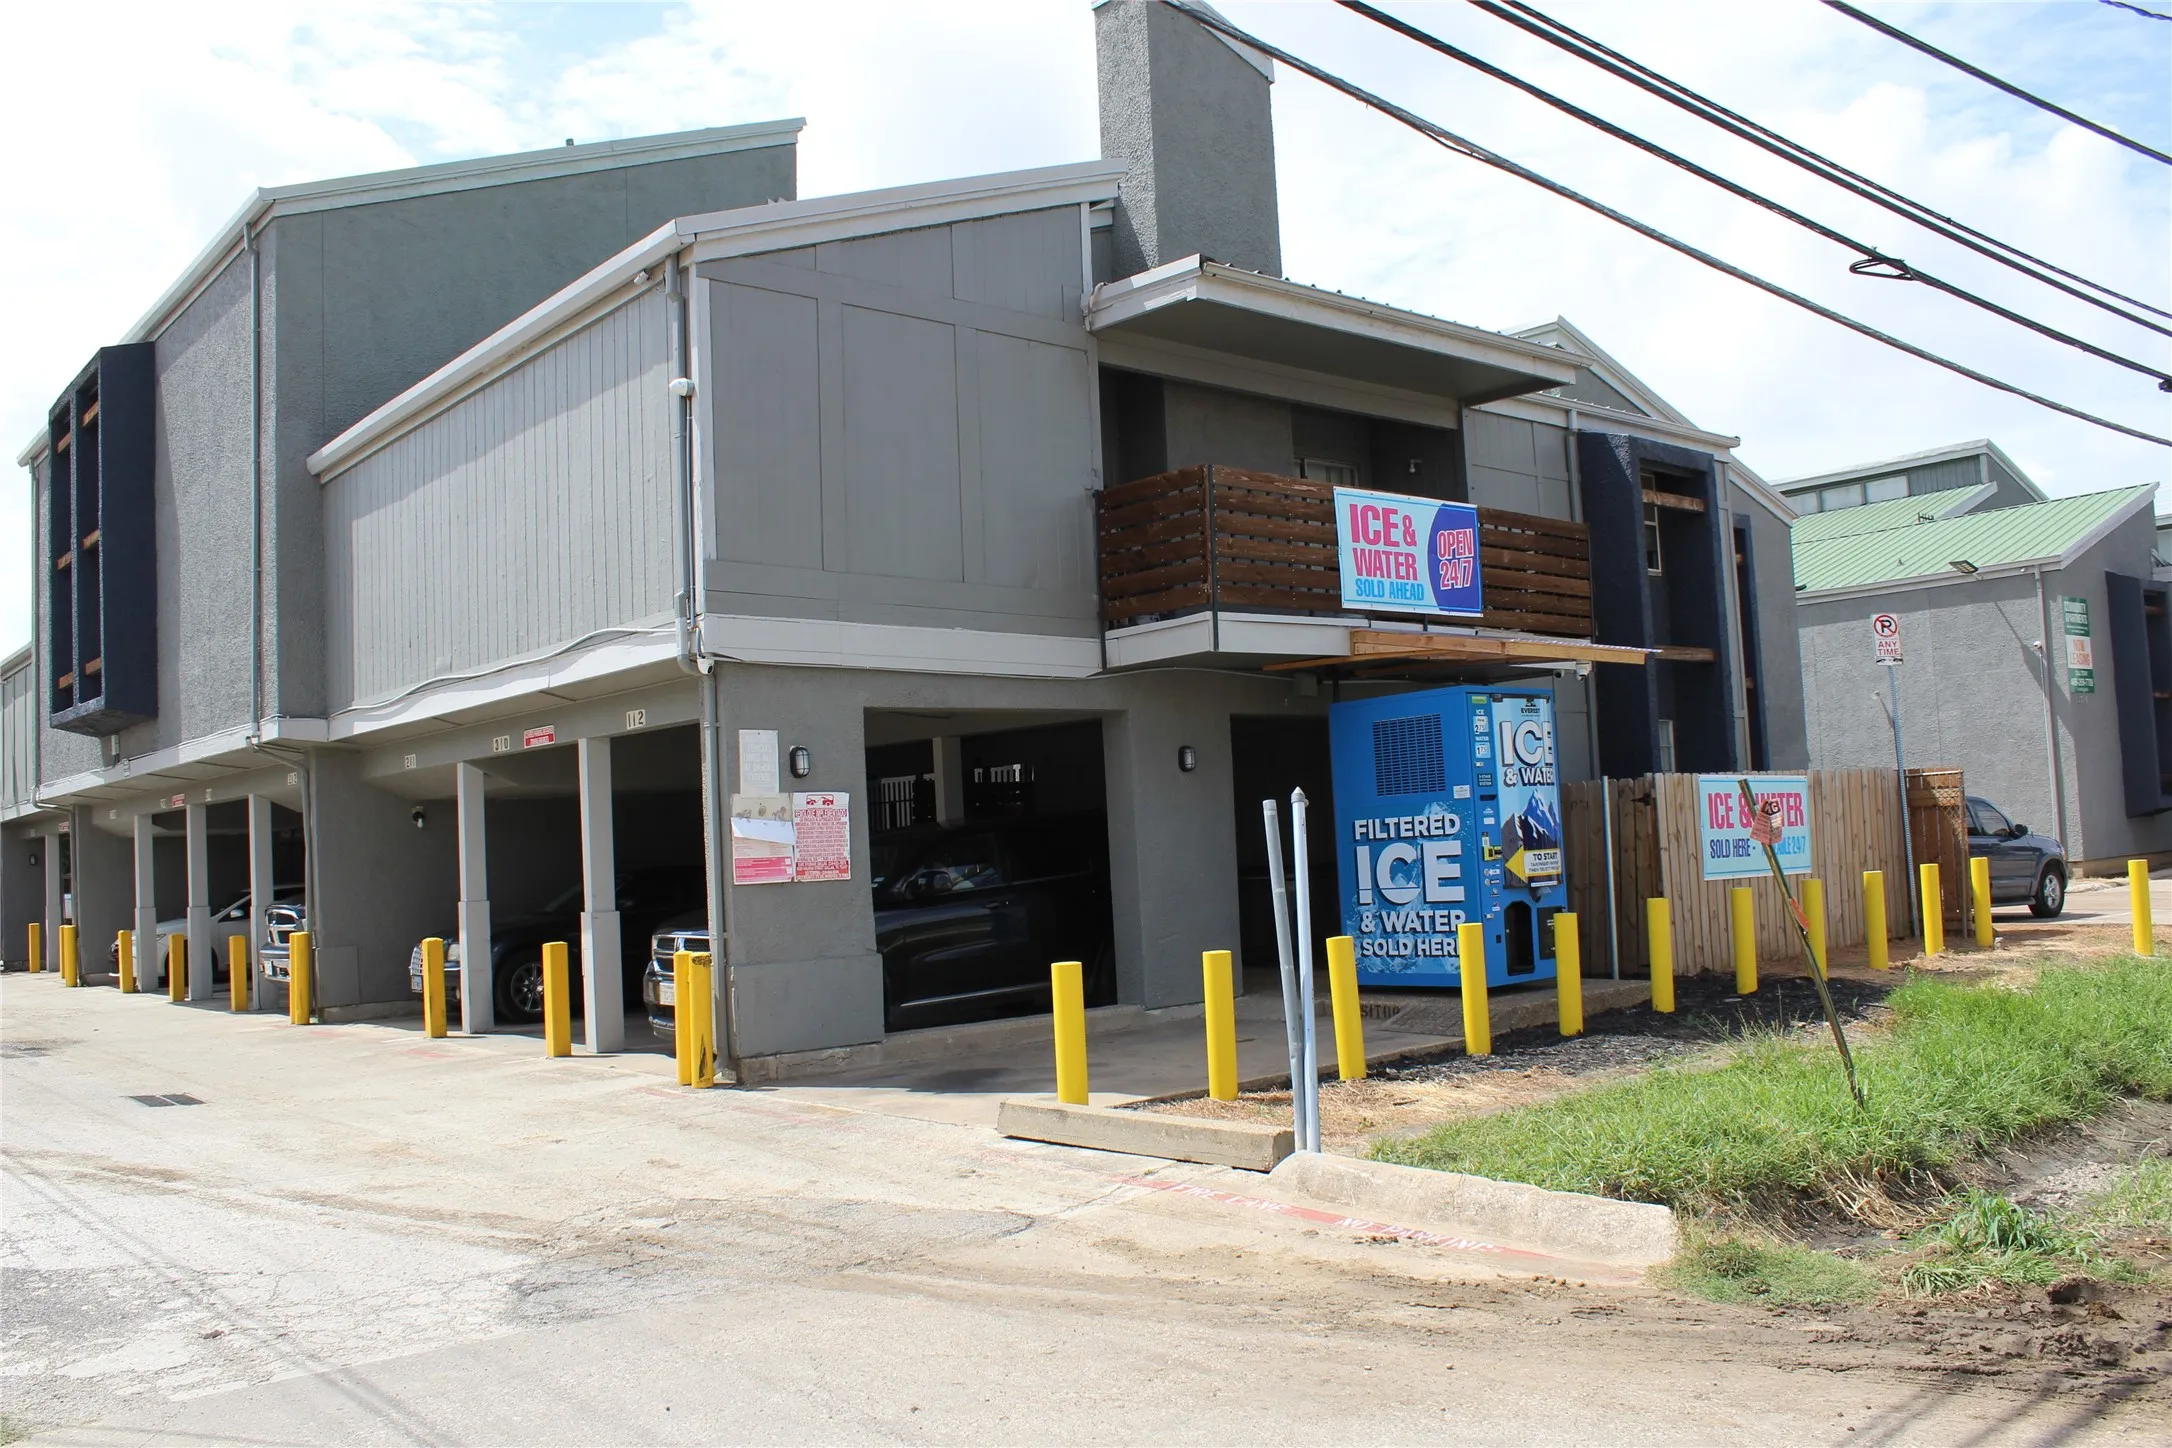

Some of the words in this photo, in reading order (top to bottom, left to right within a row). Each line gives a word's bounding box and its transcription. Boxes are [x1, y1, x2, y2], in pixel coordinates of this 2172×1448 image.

[1349, 503, 1400, 547] ICE
[1402, 514, 1417, 547] &
[1436, 528, 1474, 560] OPEN
[1352, 547, 1418, 581] WATER
[1439, 557, 1473, 590] 24/7
[1355, 578, 1385, 598] SOLD
[1389, 581, 1424, 601] AHEAD
[1877, 648, 1899, 656] TIME
[1500, 720, 1554, 767] ICE
[1504, 768, 1518, 786] &
[1707, 792, 1735, 830] ICE
[1354, 813, 1461, 840] FILTERED
[1532, 853, 1542, 861] TO
[1543, 852, 1558, 860] START
[1710, 839, 1731, 859] SOLD
[1732, 838, 1751, 858] HERE
[1356, 840, 1466, 904] ICE
[1360, 911, 1376, 933] &
[1361, 938, 1412, 957] SOLD
[1417, 938, 1460, 956] HER
[1169, 1183, 1226, 1198] FIRE
[1226, 1196, 1290, 1212] LANE
[1335, 1217, 1375, 1230] NO
[1380, 1225, 1500, 1251] PARKING
